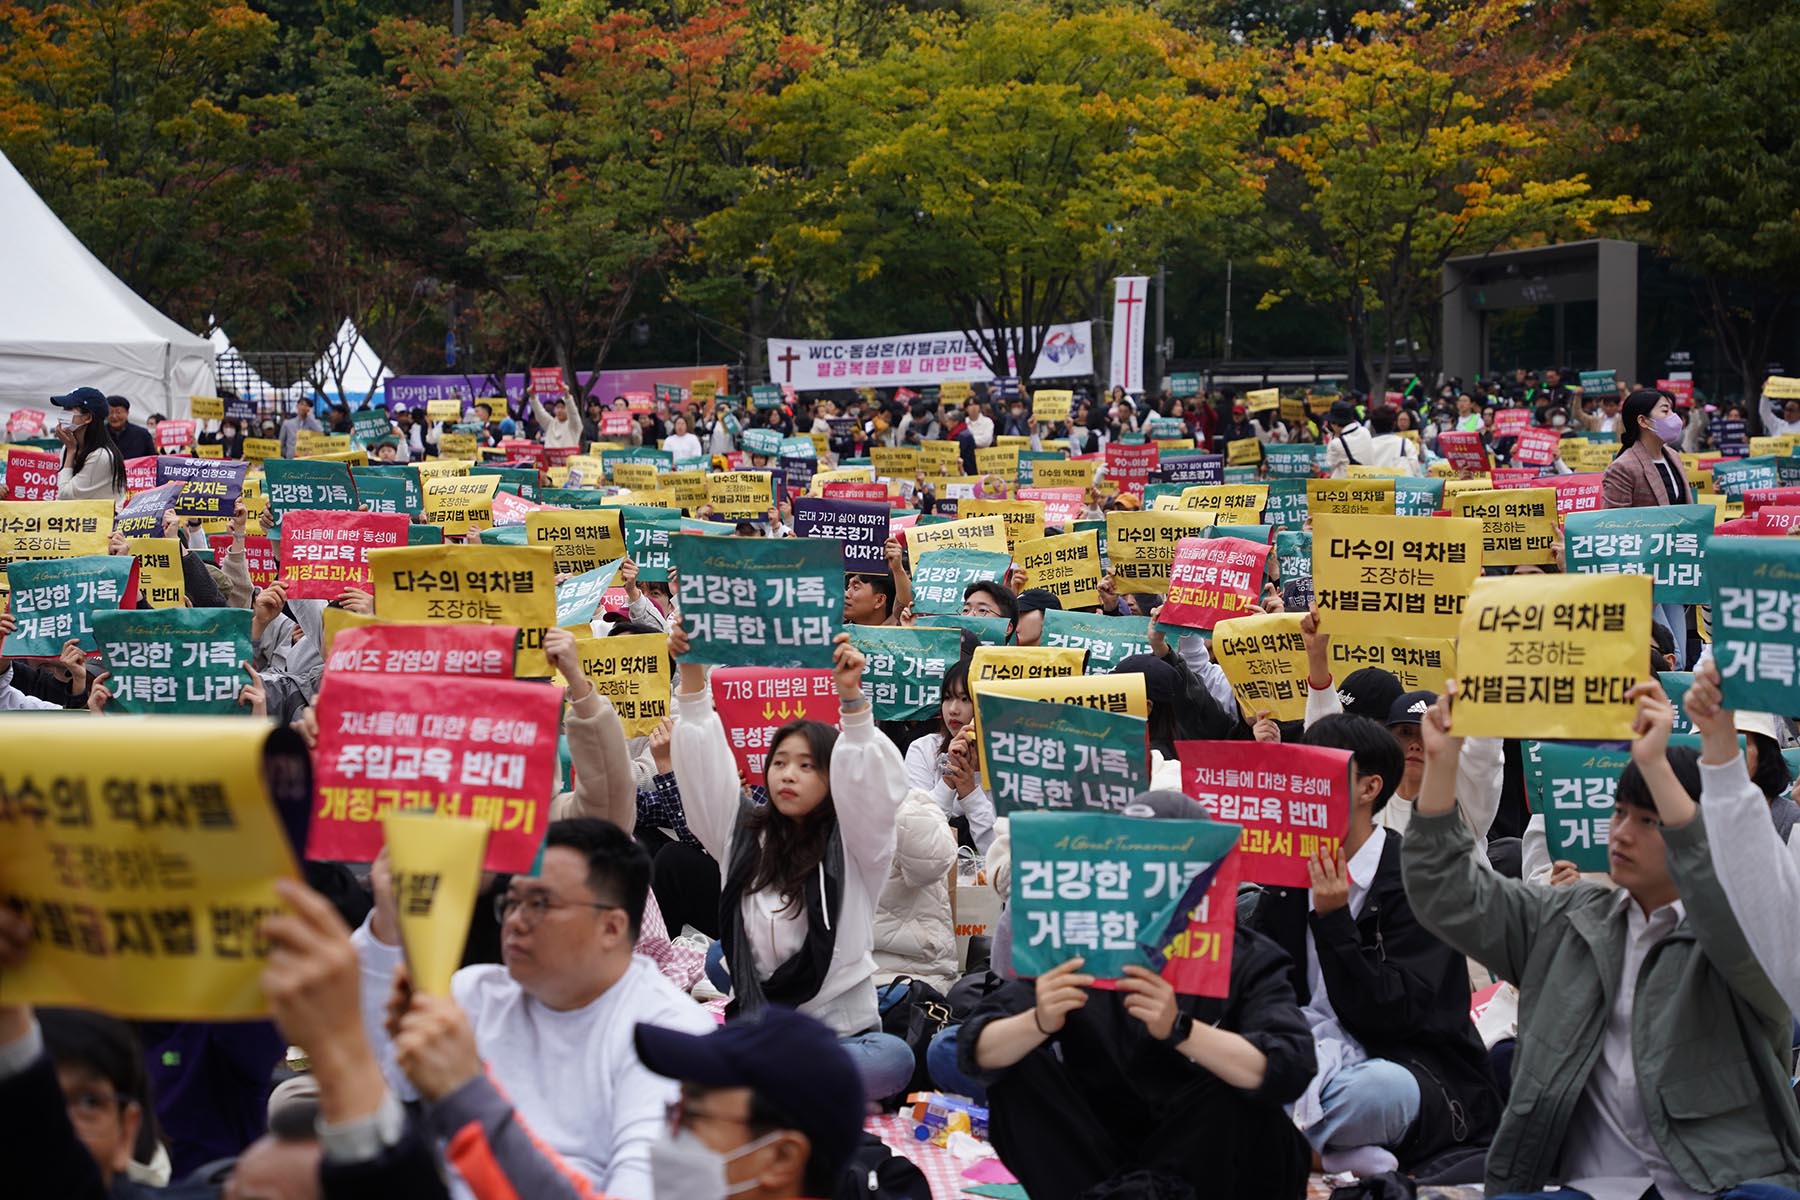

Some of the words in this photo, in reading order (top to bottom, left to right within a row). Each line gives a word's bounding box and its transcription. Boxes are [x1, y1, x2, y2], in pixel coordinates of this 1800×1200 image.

[1266, 453, 1291, 464] 건강한
[164, 466, 200, 477] 피부양자
[202, 467, 236, 479] 인정으로
[713, 474, 737, 483] 다수의
[741, 474, 764, 483] 역차별
[1040, 469, 1061, 477] 다수의
[1171, 470, 1214, 480] 스포츠경기
[271, 483, 312, 502] 건강한
[316, 485, 352, 504] 가족,
[429, 484, 456, 495] 다수의
[460, 484, 488, 494] 역차별
[726, 484, 753, 492] 조장하는
[825, 490, 843, 498] 에이즈
[845, 490, 864, 498] 감염의
[866, 490, 884, 498] 원인은
[1316, 491, 1348, 502] 다수의
[1352, 490, 1385, 502] 역차별
[1564, 488, 1576, 496] 대한
[1578, 486, 1599, 496] 동성애
[438, 498, 470, 507] 조장하는
[712, 494, 750, 503] 차별금지법
[753, 494, 768, 502] 반대
[1187, 496, 1220, 509] 다수의
[1224, 495, 1256, 508] 역차별
[1575, 498, 1596, 509] 반대
[1750, 493, 1766, 502] 7.18
[468, 510, 490, 522] 반대
[799, 510, 816, 521] 군대
[818, 512, 836, 522] 가기
[838, 513, 856, 524] 싫어
[859, 514, 885, 526] 여자?!
[1332, 504, 1369, 514] 조장하는
[1463, 505, 1500, 518] 다수의
[1504, 503, 1545, 518] 역차별
[48, 518, 98, 532] 역차별
[1002, 513, 1035, 524] 역차별
[1482, 522, 1525, 533] 조장하는
[1766, 514, 1789, 527] 7.18
[291, 530, 332, 542] 자녀들에
[337, 530, 360, 542] 대한
[363, 530, 397, 544] 동성애
[538, 526, 570, 541] 다수의
[575, 526, 610, 540] 역차별
[636, 529, 672, 549] 가족,
[808, 524, 874, 543] 스포츠경기
[917, 530, 954, 544] 다수의
[958, 525, 994, 539] 역차별
[1118, 528, 1155, 542] 다수의
[1160, 527, 1201, 541] 역차별
[14, 538, 71, 550] 조장하는
[555, 544, 596, 556] 조장하는
[1330, 538, 1393, 561] 다수의
[1403, 541, 1466, 564] 역차별
[1571, 534, 1643, 559] 건강한
[1651, 533, 1706, 559] 가족,
[292, 546, 355, 561] 주입교육
[636, 552, 670, 568] 나라
[1025, 554, 1052, 568] 다수의
[1056, 546, 1088, 561] 역차별
[1177, 546, 1207, 560] 자녀들에
[1209, 549, 1224, 562] 대한
[1226, 552, 1256, 568] 동성애
[284, 564, 362, 582] 개정교과서
[393, 570, 459, 593] 다수의
[466, 570, 534, 593] 역차별
[916, 568, 960, 583] 건강한
[966, 569, 999, 583] 가족,
[1038, 565, 1074, 580] 조장하는
[1171, 564, 1218, 584] 주입교육
[1220, 570, 1250, 590] 반대
[1360, 566, 1434, 586] 조장하는
[1654, 564, 1702, 587] 나라
[680, 574, 757, 608] 건강한
[766, 576, 835, 609] 가족,
[1074, 577, 1098, 592] 반대
[16, 583, 70, 612] 건강한
[152, 588, 180, 602] 반대
[914, 586, 957, 602] 거룩한
[1318, 590, 1426, 614] 차별금지법
[428, 600, 502, 619] 조장하는
[1478, 604, 1546, 632] 다수의
[1553, 603, 1625, 631] 역차별
[16, 612, 72, 640] 거룩한
[684, 614, 766, 645] 거룩한
[774, 616, 832, 646] 나라
[106, 642, 174, 669] 건강한
[182, 641, 244, 668] 가족,
[1222, 636, 1258, 657] 다수의
[1506, 640, 1586, 666] 조장하는
[330, 651, 380, 672] 에이즈
[385, 650, 441, 672] 감염의
[444, 651, 502, 672] 원인은
[1333, 644, 1385, 664] 다수의
[1391, 646, 1441, 668] 역차별
[583, 658, 615, 676] 다수의
[620, 656, 658, 674] 역차별
[981, 664, 1024, 680] 다수의
[1246, 659, 1292, 676] 조장하는
[112, 676, 178, 702] 거룩한
[187, 676, 242, 701] 나라
[600, 681, 640, 696] 조장하는
[722, 680, 752, 701] 7.18
[757, 676, 808, 699] 대법원
[1460, 675, 1574, 704] 차별금지법
[1584, 676, 1636, 705] 반대
[640, 700, 665, 718] 반대
[338, 712, 418, 736] 자녀들에
[422, 714, 465, 740] 대한
[469, 717, 537, 746] 동성애
[990, 731, 1066, 770] 건강한
[1073, 744, 1138, 782] 가족,
[336, 746, 452, 782] 주입교육
[460, 750, 525, 789] 반대
[996, 771, 1073, 807] 거룩한
[1195, 768, 1253, 788] 자녀들에
[1257, 772, 1287, 792] 대한
[1290, 776, 1331, 797] 동성애
[103, 778, 236, 830] 역차별
[1199, 793, 1282, 825] 주입교육
[1289, 800, 1328, 830] 반대
[472, 795, 536, 834] 폐기
[1020, 860, 1132, 899] 건강한
[1028, 910, 1139, 950] 거룩한
